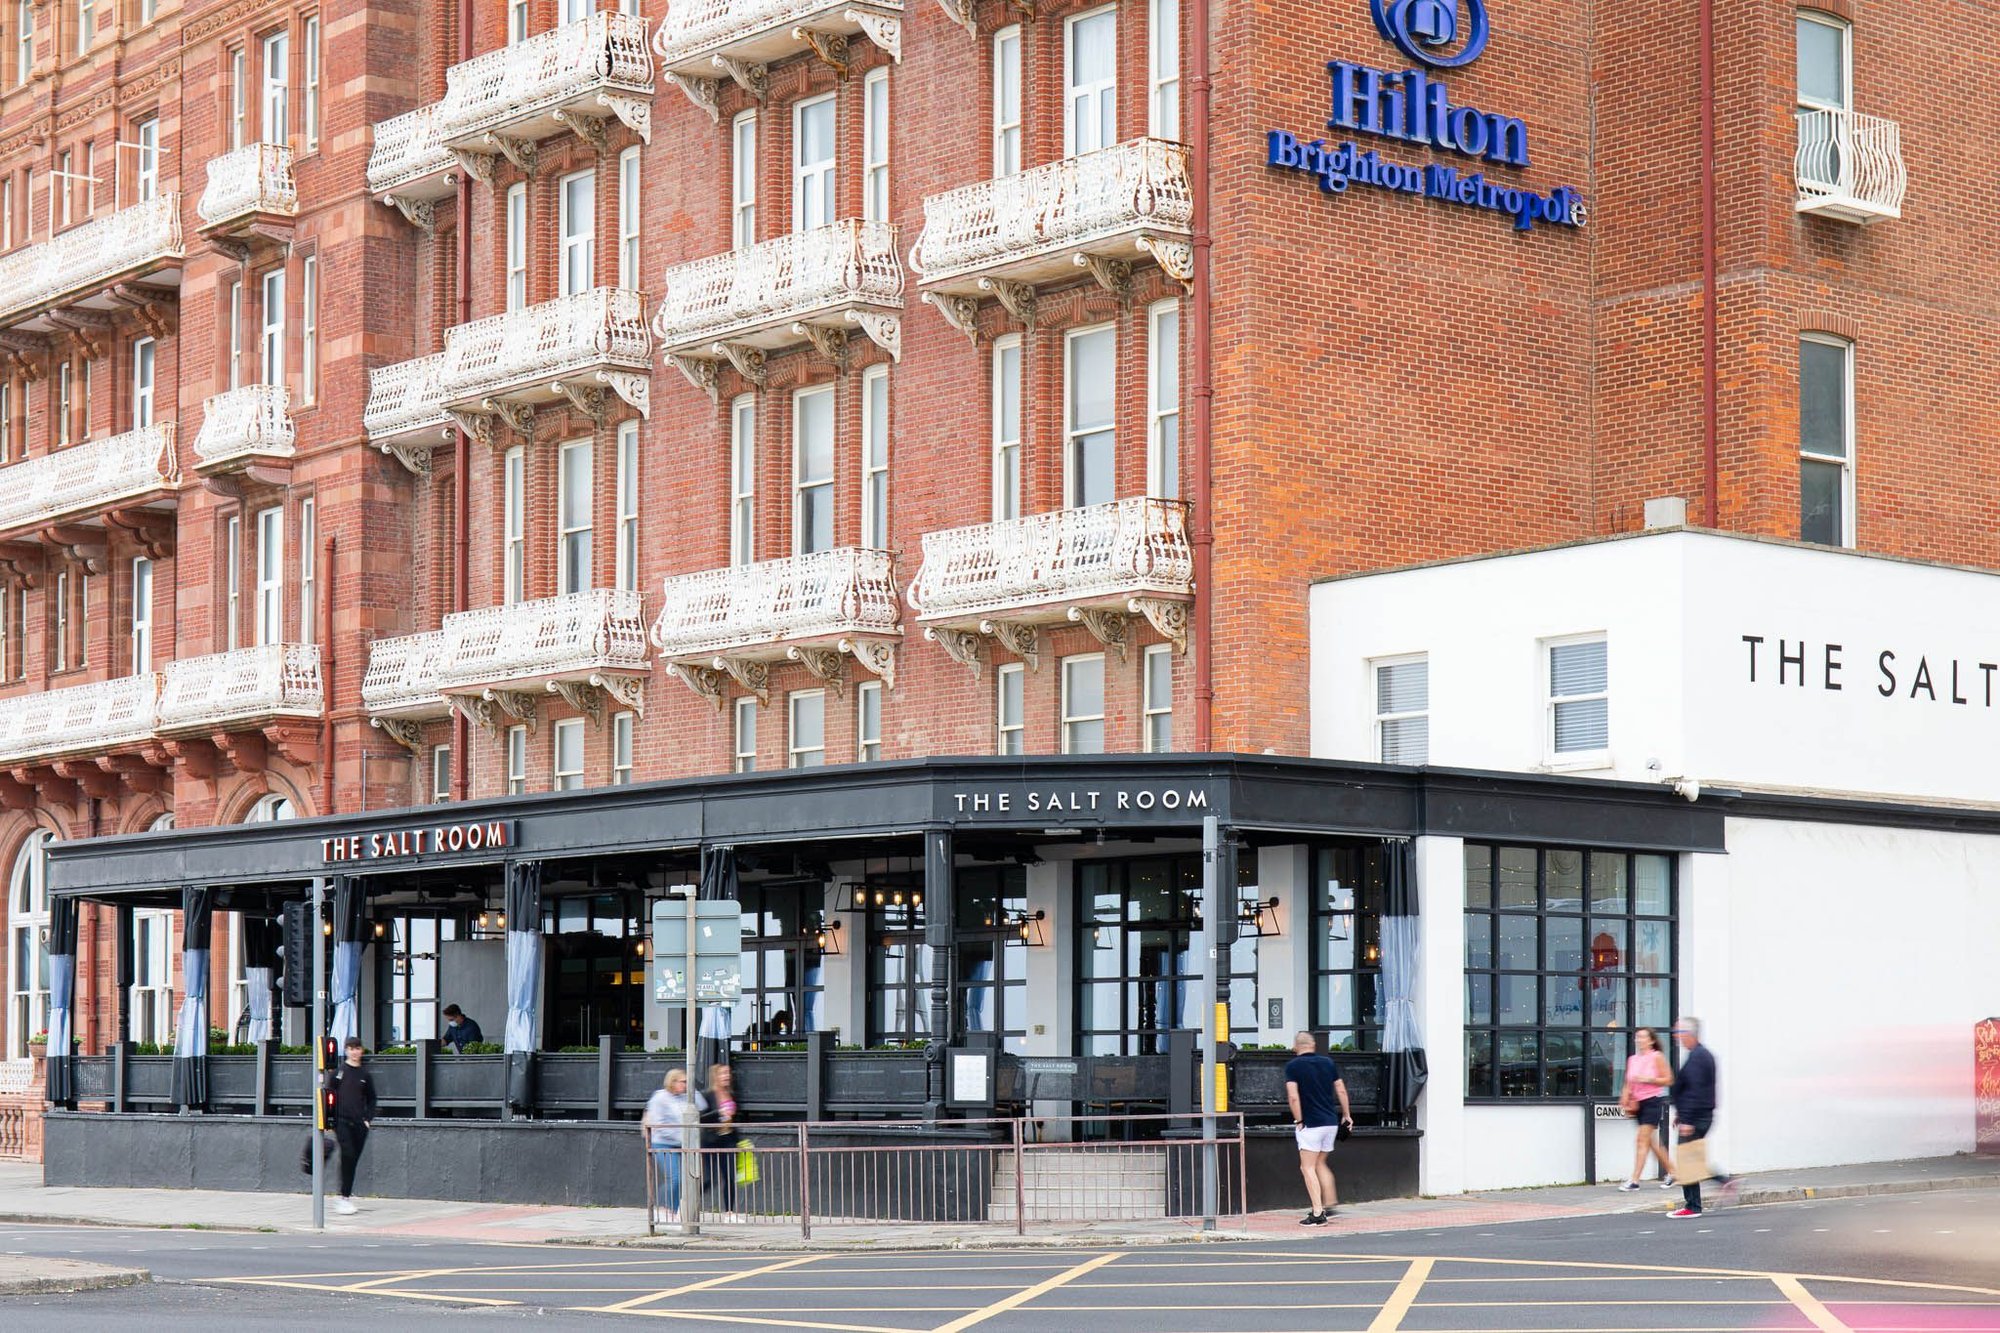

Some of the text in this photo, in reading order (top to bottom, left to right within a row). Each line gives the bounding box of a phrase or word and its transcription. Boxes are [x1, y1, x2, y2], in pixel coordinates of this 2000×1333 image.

[1327, 60, 1531, 167] Hilton
[1266, 130, 1588, 231] Brighton Metropole
[1742, 635, 1998, 708] THE SALT
[954, 789, 1208, 812] THE SALT ROOM
[320, 821, 505, 862] THE SALT ROOM
